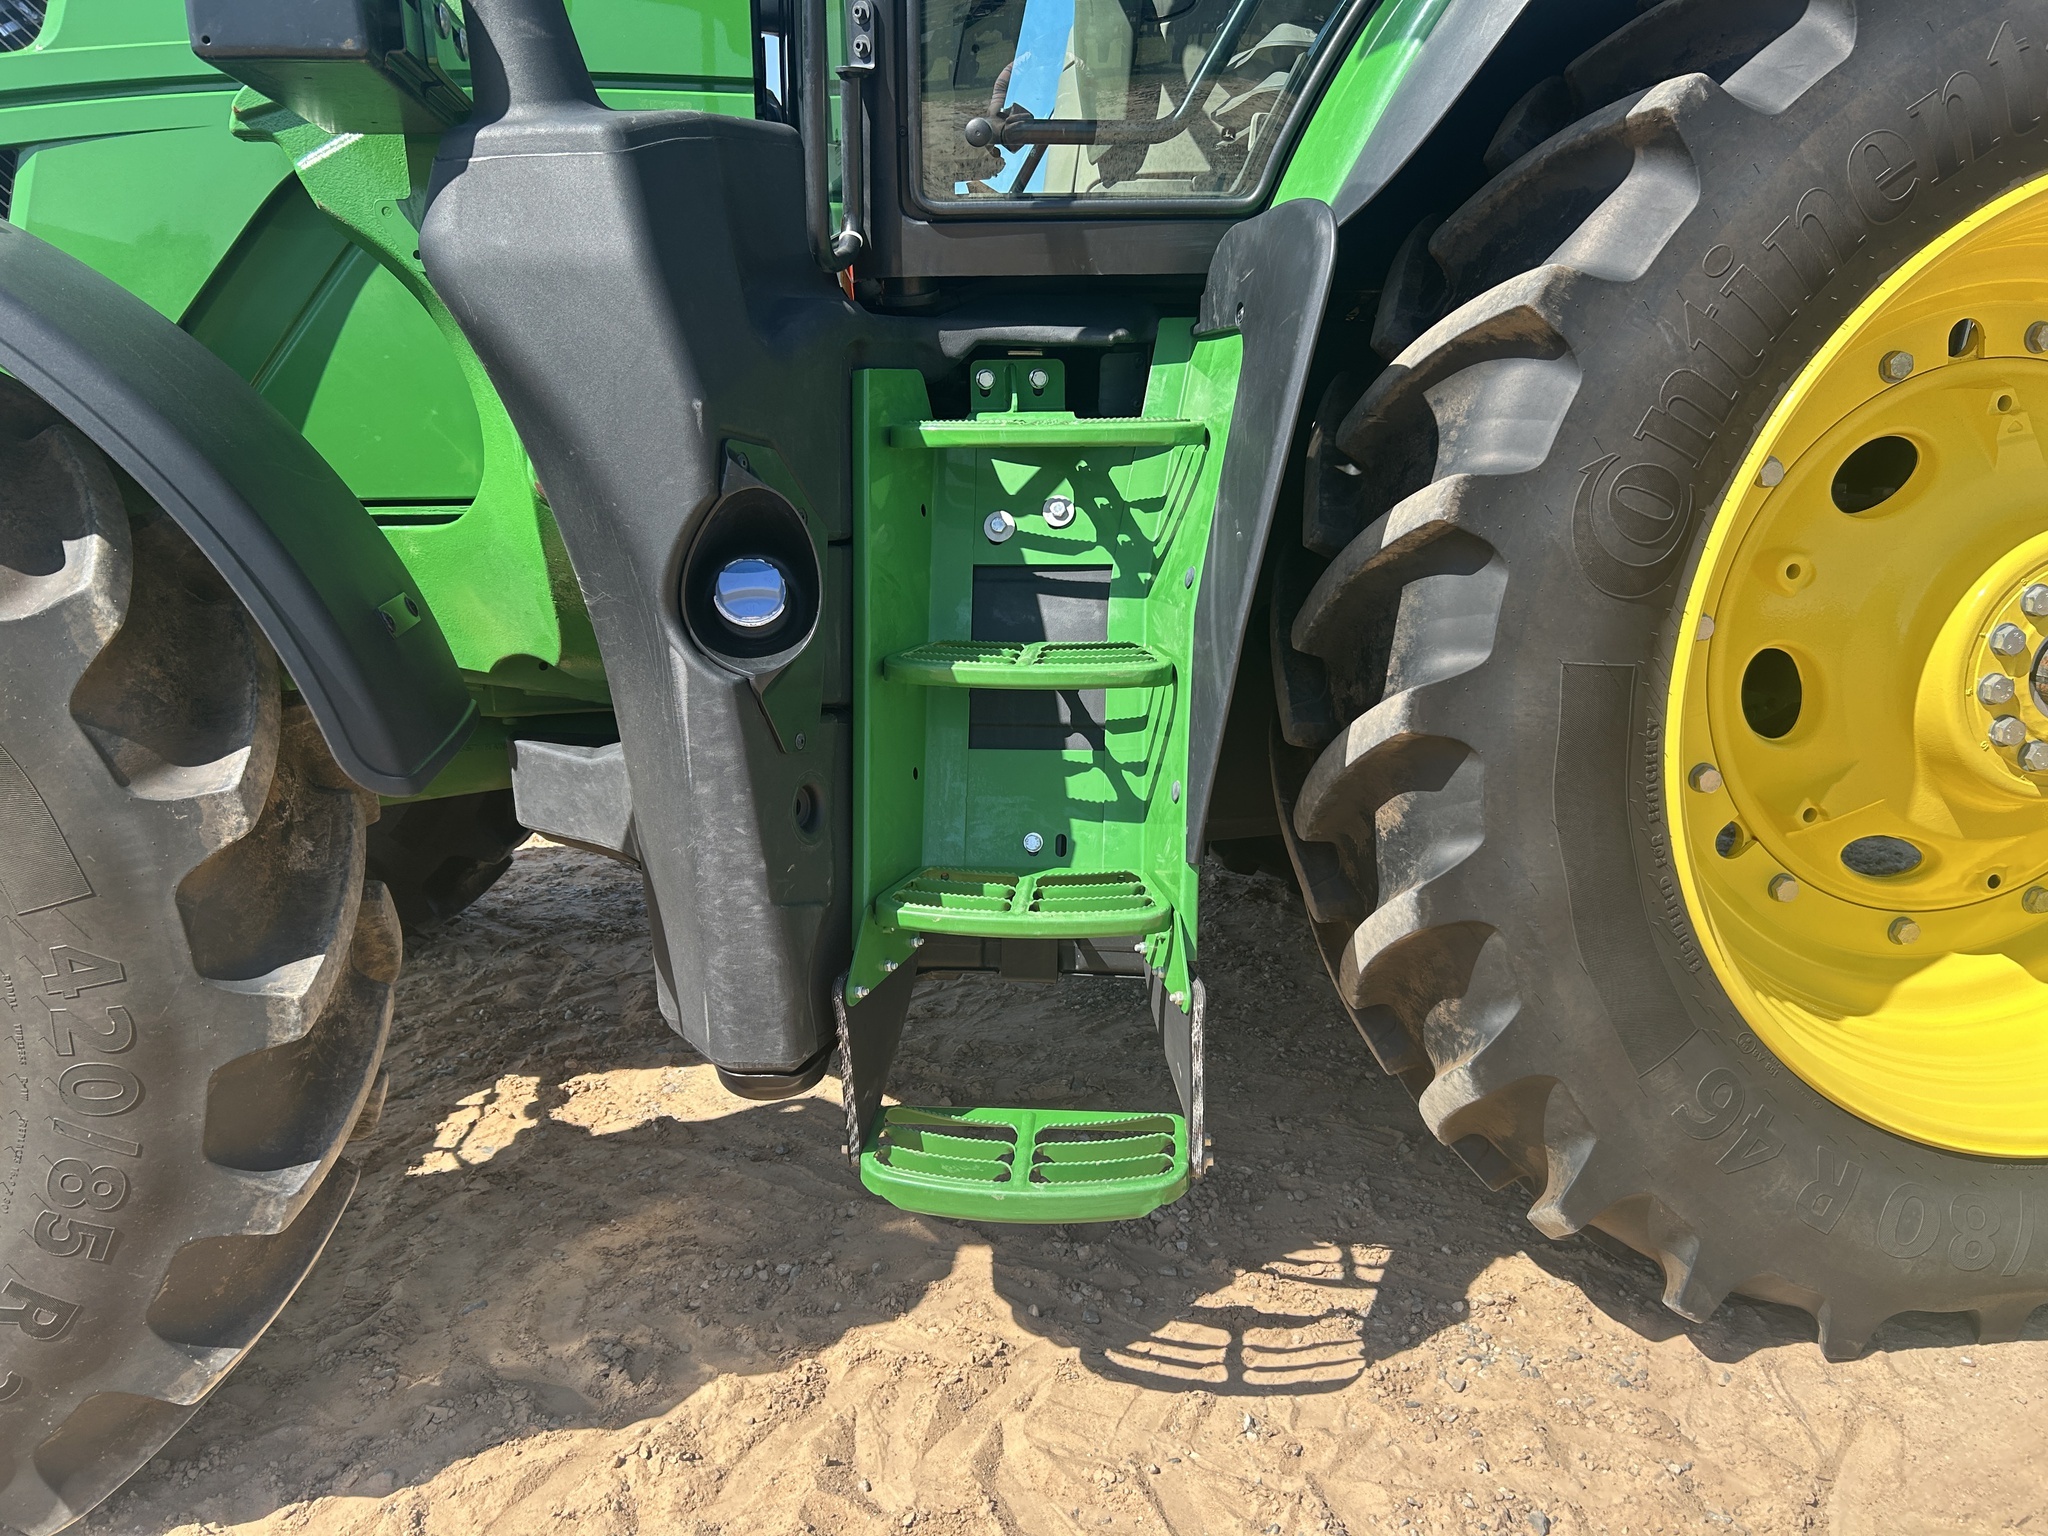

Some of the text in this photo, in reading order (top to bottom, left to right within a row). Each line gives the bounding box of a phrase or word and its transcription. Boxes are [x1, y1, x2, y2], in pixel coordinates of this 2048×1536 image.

[1571, 19, 2048, 598] Continent
[1644, 716, 1702, 974] ENGINEERED FOR EFFICIENCY
[0, 945, 142, 1341] 420/85 R
[1671, 1066, 1786, 1175] 46
[1794, 1145, 1863, 1236] R
